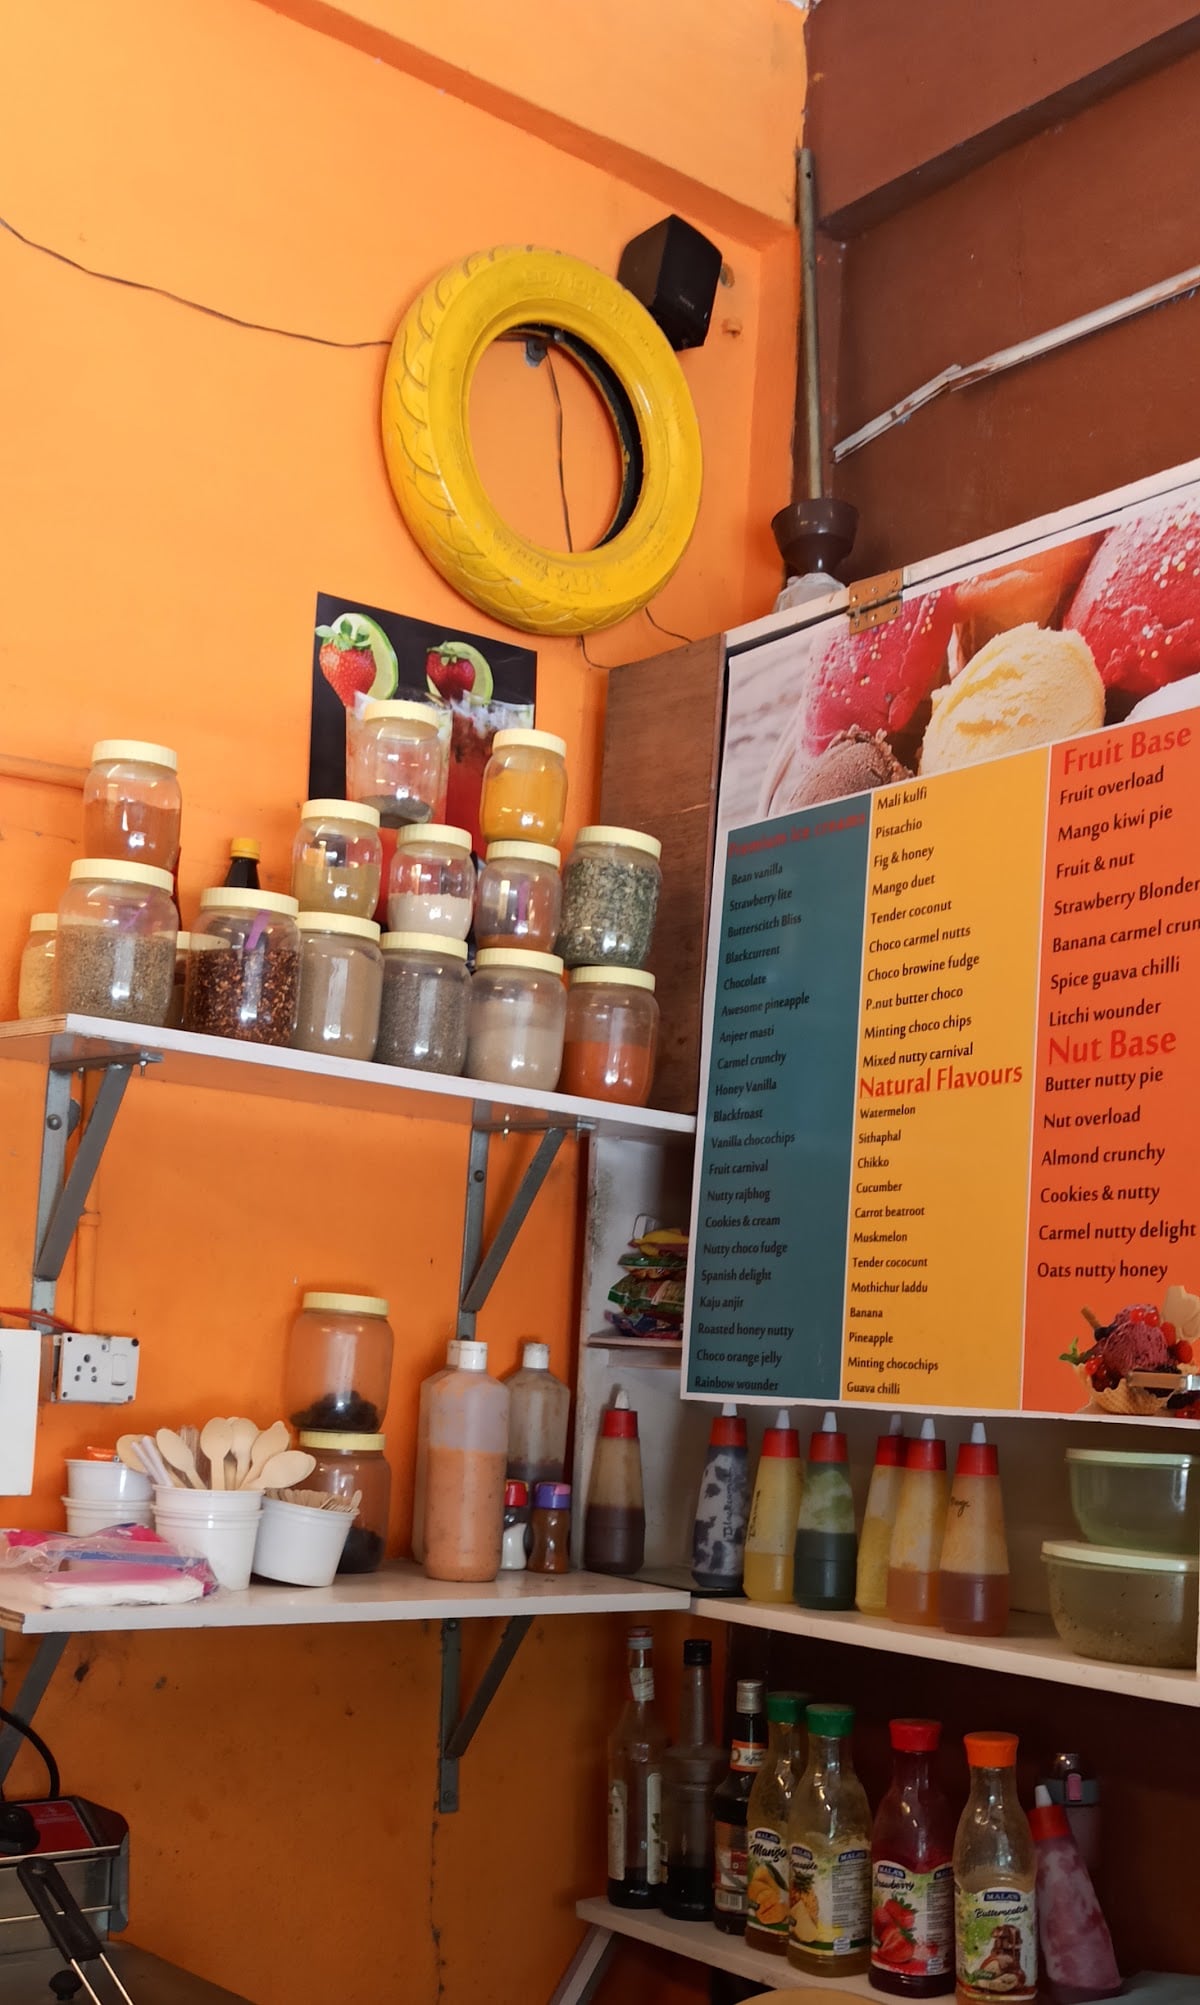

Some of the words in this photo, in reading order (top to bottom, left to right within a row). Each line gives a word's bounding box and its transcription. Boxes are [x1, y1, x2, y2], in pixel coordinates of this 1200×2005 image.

[1064, 739, 1123, 775] Fruit
[1131, 726, 1191, 759] Base
[1060, 784, 1094, 805] Fruit
[1098, 765, 1164, 797] overload
[877, 793, 901, 810] Mali
[903, 787, 927, 804] kulfi
[875, 819, 922, 838] Pistachio
[1058, 819, 1109, 842] Mango
[1113, 809, 1145, 831] kiwi
[1149, 805, 1173, 829] pie
[874, 855, 888, 870] Fig
[891, 852, 900, 864] &
[901, 845, 935, 861] honey
[1056, 859, 1090, 880] Fruit
[1094, 856, 1105, 872] &
[1109, 852, 1135, 869] nut
[731, 871, 752, 886] Bean
[754, 862, 783, 880] vanilla
[872, 880, 909, 896] Mango
[911, 874, 935, 888] duet
[729, 891, 777, 912] Strawberry
[777, 889, 792, 901] lite
[1054, 891, 1135, 916] Strawberry
[781, 914, 802, 925] Bliss
[871, 909, 906, 925] Tender
[909, 900, 952, 917] coconut
[869, 938, 901, 954] Choco
[903, 929, 939, 947] carmel
[942, 925, 971, 940] nutts
[1053, 932, 1105, 953] Banana
[1110, 919, 1161, 944] carmel
[867, 967, 900, 982] Choco
[902, 959, 945, 976] browine
[948, 952, 980, 971] fudge
[1051, 970, 1088, 994] Spice
[1092, 961, 1137, 990] guava
[1141, 956, 1180, 977] chilli
[724, 974, 767, 990] Chocolate
[721, 1003, 764, 1017] Awesome
[765, 993, 810, 1014] pineapple
[866, 997, 893, 1010] P.nut
[896, 992, 929, 1007] butter
[931, 987, 963, 1000] choco
[1050, 1007, 1089, 1027] Litchi
[1093, 998, 1161, 1021] wounder
[719, 1029, 748, 1044] Anjeer
[749, 1025, 774, 1038] masti
[864, 1024, 906, 1039] Minting
[908, 1020, 940, 1034] choco
[943, 1014, 972, 1032] chips
[863, 1052, 896, 1068] Mixed
[898, 1048, 928, 1066] nutty
[929, 1042, 973, 1059] carnival
[1050, 1036, 1102, 1066] Nut
[1110, 1028, 1177, 1060] Base
[717, 1054, 749, 1070] Carmel
[750, 1050, 786, 1066] crunchy
[715, 1082, 746, 1098] Honey
[746, 1079, 777, 1093] Vanilla
[860, 1068, 932, 1099] Natural
[937, 1065, 1023, 1091] Flavours
[1045, 1076, 1091, 1092] Butter
[1095, 1072, 1136, 1090] nutty
[1140, 1066, 1163, 1089] pie
[860, 1105, 916, 1119] Watermelon
[1044, 1113, 1071, 1129] Nut
[1075, 1105, 1140, 1126] overload
[711, 1136, 742, 1148] Vanilla
[744, 1132, 795, 1147] chocochips
[858, 1130, 901, 1145] Sithaphal
[858, 1157, 889, 1169] Chikko
[1042, 1146, 1099, 1166] Almond
[1103, 1143, 1165, 1166] crunchy
[709, 1163, 730, 1175] Fruit
[732, 1160, 768, 1174] carnival
[707, 1190, 734, 1204] Nutty
[735, 1188, 771, 1204] rajbhog
[856, 1181, 902, 1193] Cucumber
[1040, 1186, 1098, 1203] Cookies
[1102, 1186, 1113, 1200] &
[1117, 1186, 1160, 1205] nutty
[855, 1207, 883, 1218] Carrot
[885, 1206, 925, 1217] beatroot
[705, 1216, 741, 1228] Cookies
[743, 1216, 750, 1227] &
[752, 1217, 780, 1226] cream
[854, 1231, 907, 1243] Muskmelon
[1039, 1223, 1090, 1241] Carmel
[1094, 1224, 1136, 1244] nutty
[1140, 1220, 1196, 1243] delight
[703, 1243, 730, 1258] Nutty
[732, 1243, 759, 1253] choco
[761, 1241, 788, 1257] fudge
[852, 1257, 883, 1269] Tender
[885, 1257, 927, 1268] cococunt
[1037, 1262, 1071, 1278] Oats
[1075, 1263, 1115, 1283] nutty
[1120, 1259, 1167, 1283] honey
[701, 1269, 737, 1284] Spanish
[739, 1269, 772, 1284] delight
[851, 1282, 899, 1293] Mothichur
[901, 1282, 928, 1293] laddu
[700, 1296, 721, 1311] Kaju
[722, 1297, 744, 1311] anjir
[850, 1308, 883, 1318] Banana
[699, 1323, 735, 1335] Roasted
[737, 1324, 766, 1338] honey
[768, 1325, 794, 1339] nutty
[849, 1332, 893, 1347] Pineapple
[696, 1350, 725, 1362] Choco
[727, 1353, 759, 1366] orange
[761, 1351, 782, 1367] jelly
[848, 1357, 884, 1372] Minting
[887, 1358, 938, 1374] chocochips
[695, 1376, 734, 1389] Rainbow
[736, 1379, 779, 1392] wounder
[847, 1382, 875, 1393] Guava
[877, 1383, 900, 1394] chilli
[750, 1843, 787, 1862] Mango
